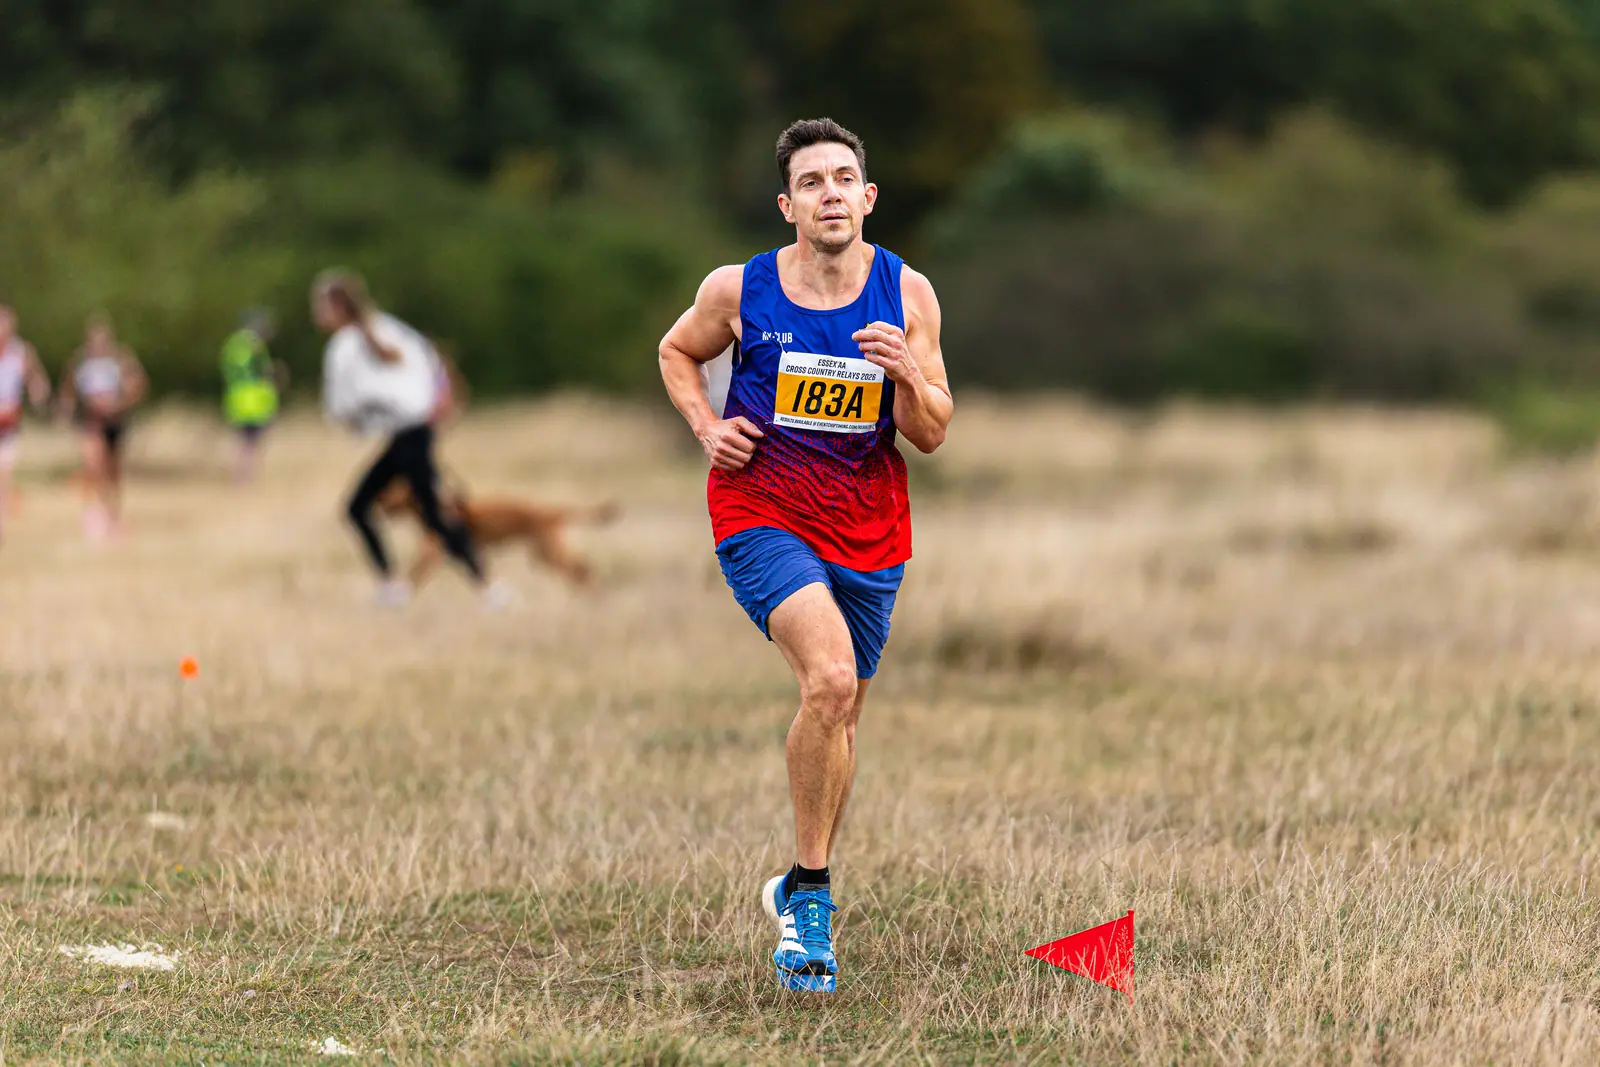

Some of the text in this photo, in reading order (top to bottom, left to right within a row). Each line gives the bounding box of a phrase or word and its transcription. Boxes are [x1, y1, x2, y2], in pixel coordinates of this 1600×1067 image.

[785, 364, 807, 374] CROSS
[807, 366, 837, 377] COUNTRY
[836, 370, 861, 380] RELAYS
[818, 359, 847, 369] ESSEX AA
[791, 380, 864, 419] 183A
